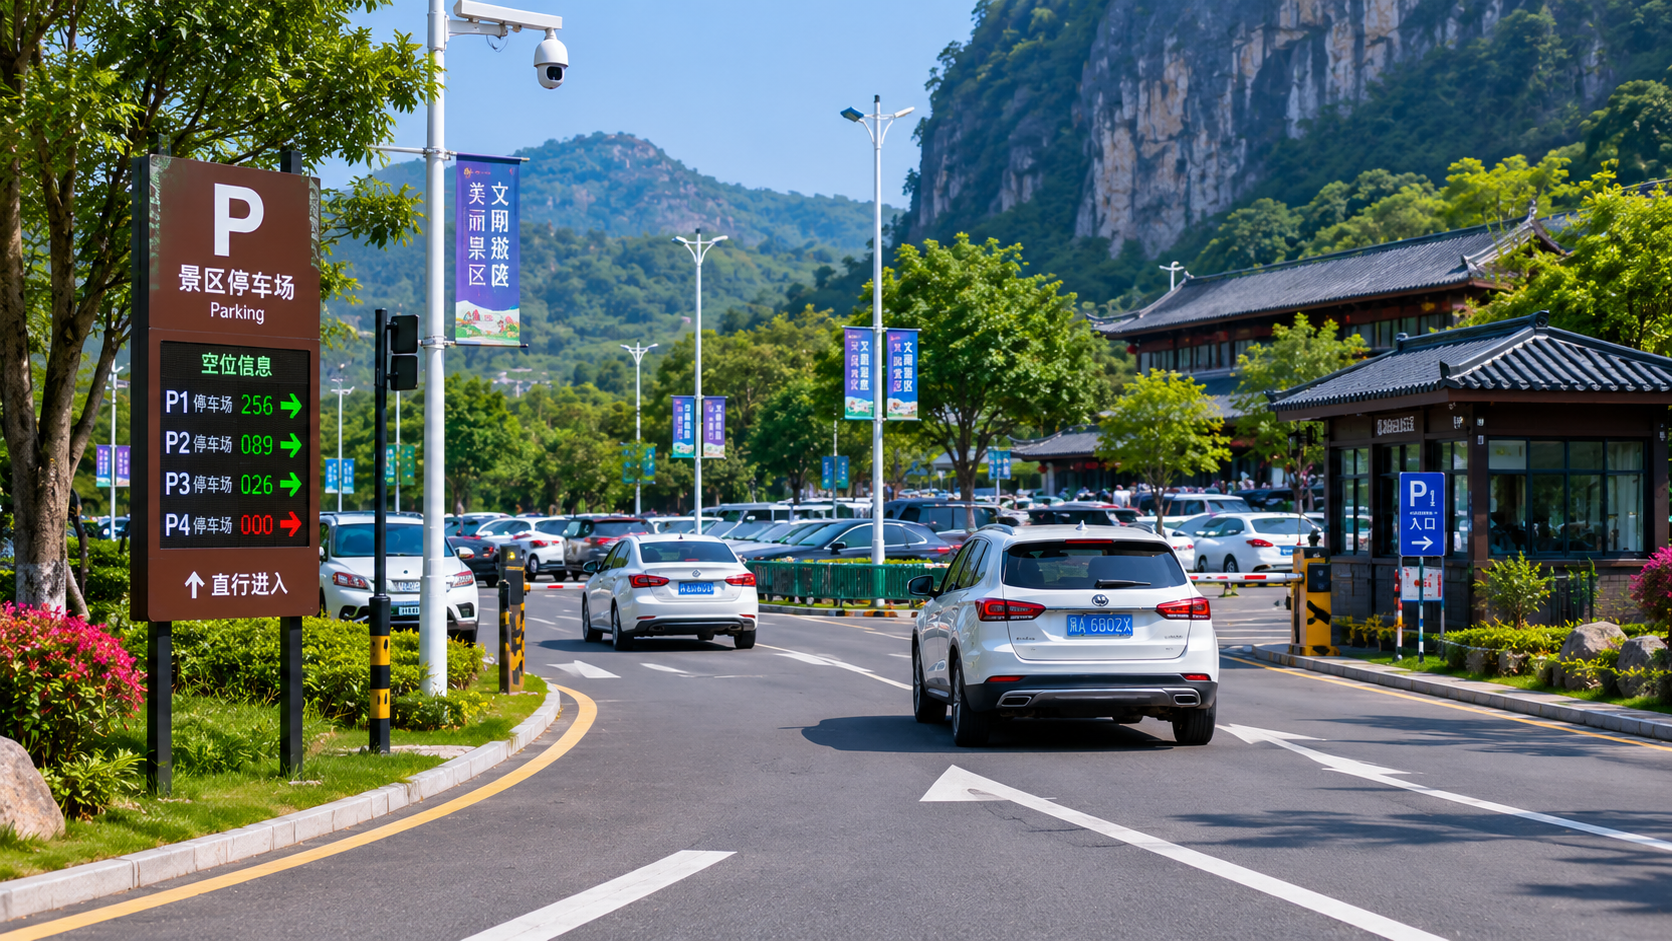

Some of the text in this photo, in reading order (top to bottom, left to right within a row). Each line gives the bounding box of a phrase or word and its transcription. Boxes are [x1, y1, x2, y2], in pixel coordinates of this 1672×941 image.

[214, 183, 264, 257] P
[179, 264, 295, 301] 景区停车场
[210, 302, 265, 325] Parking
[201, 352, 273, 378] 空位信息
[165, 390, 273, 416] P1 停车场 256
[165, 430, 273, 455] P2 停车场 089
[165, 471, 273, 495] P3 停车场 026
[165, 513, 273, 536] P4 停车场 000
[1409, 517, 1436, 531] 入口
[211, 572, 288, 597] 直行进入
